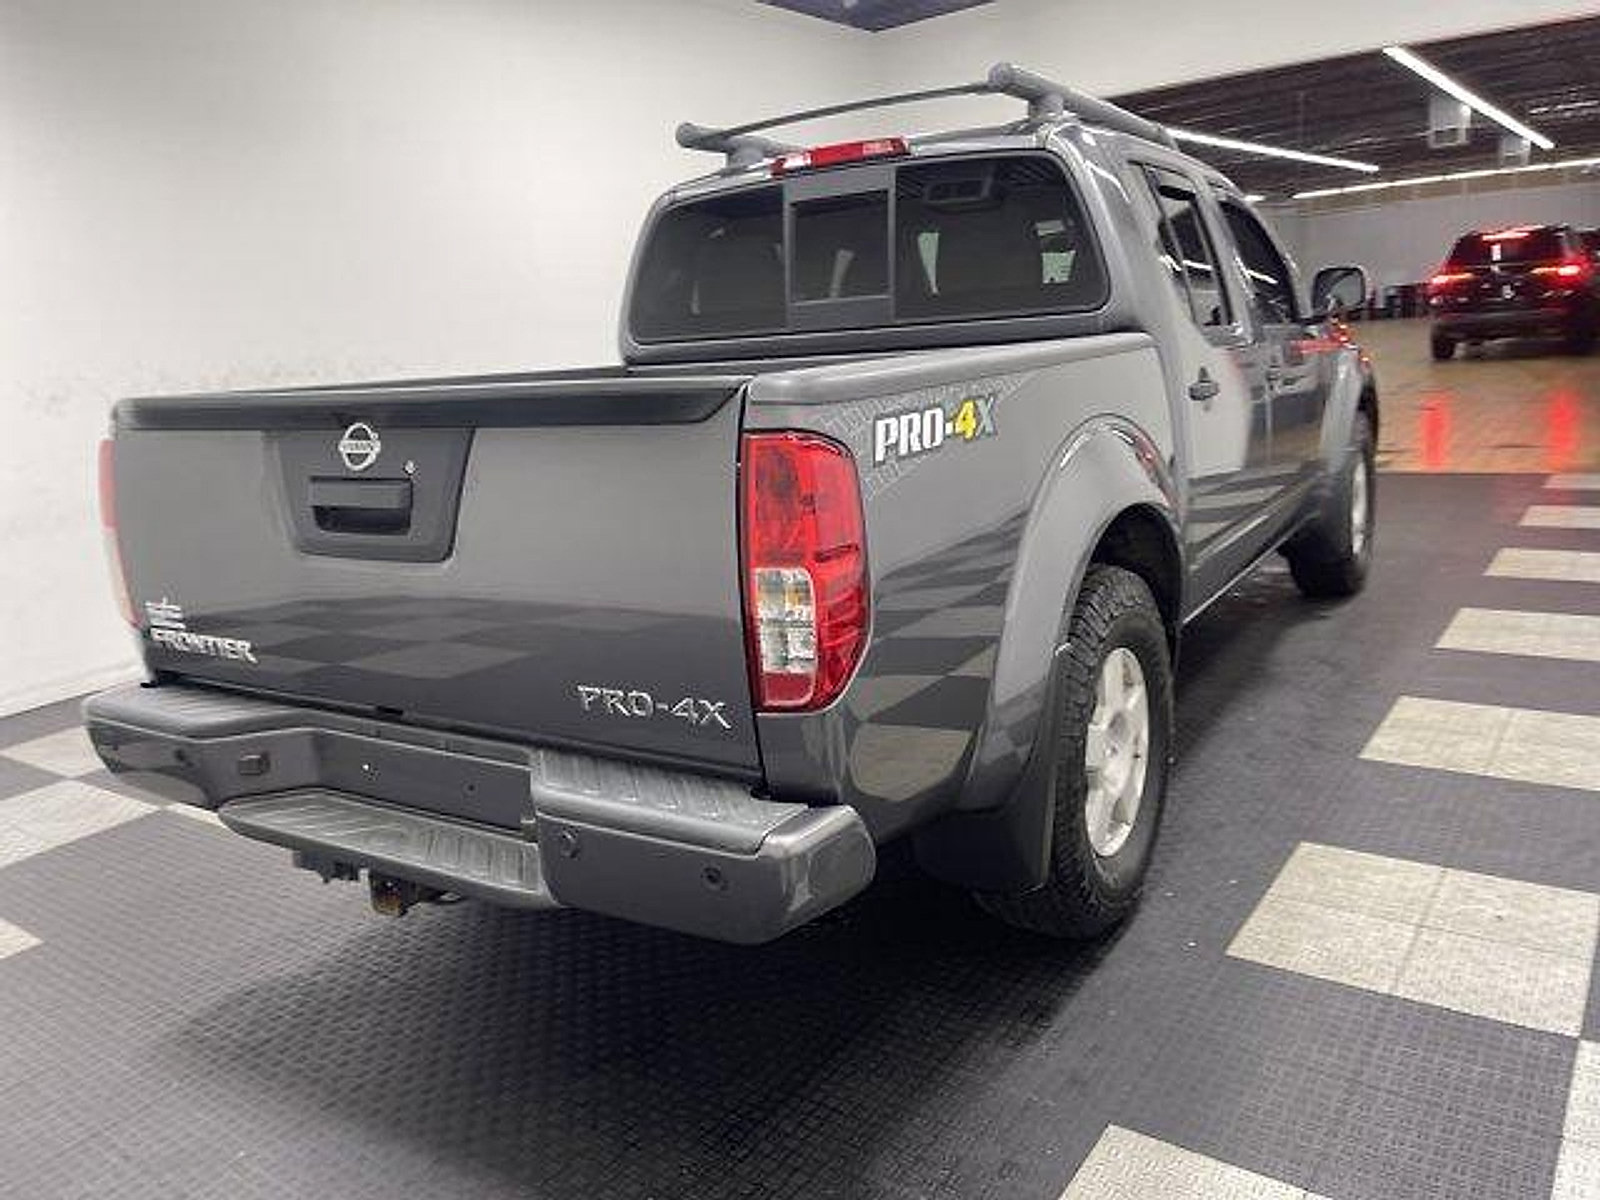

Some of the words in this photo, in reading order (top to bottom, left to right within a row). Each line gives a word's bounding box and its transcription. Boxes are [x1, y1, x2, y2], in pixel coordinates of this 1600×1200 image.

[874, 397, 997, 463] PRO-4X
[150, 628, 258, 663] FRONTIER
[577, 684, 732, 729] PRO-4X
